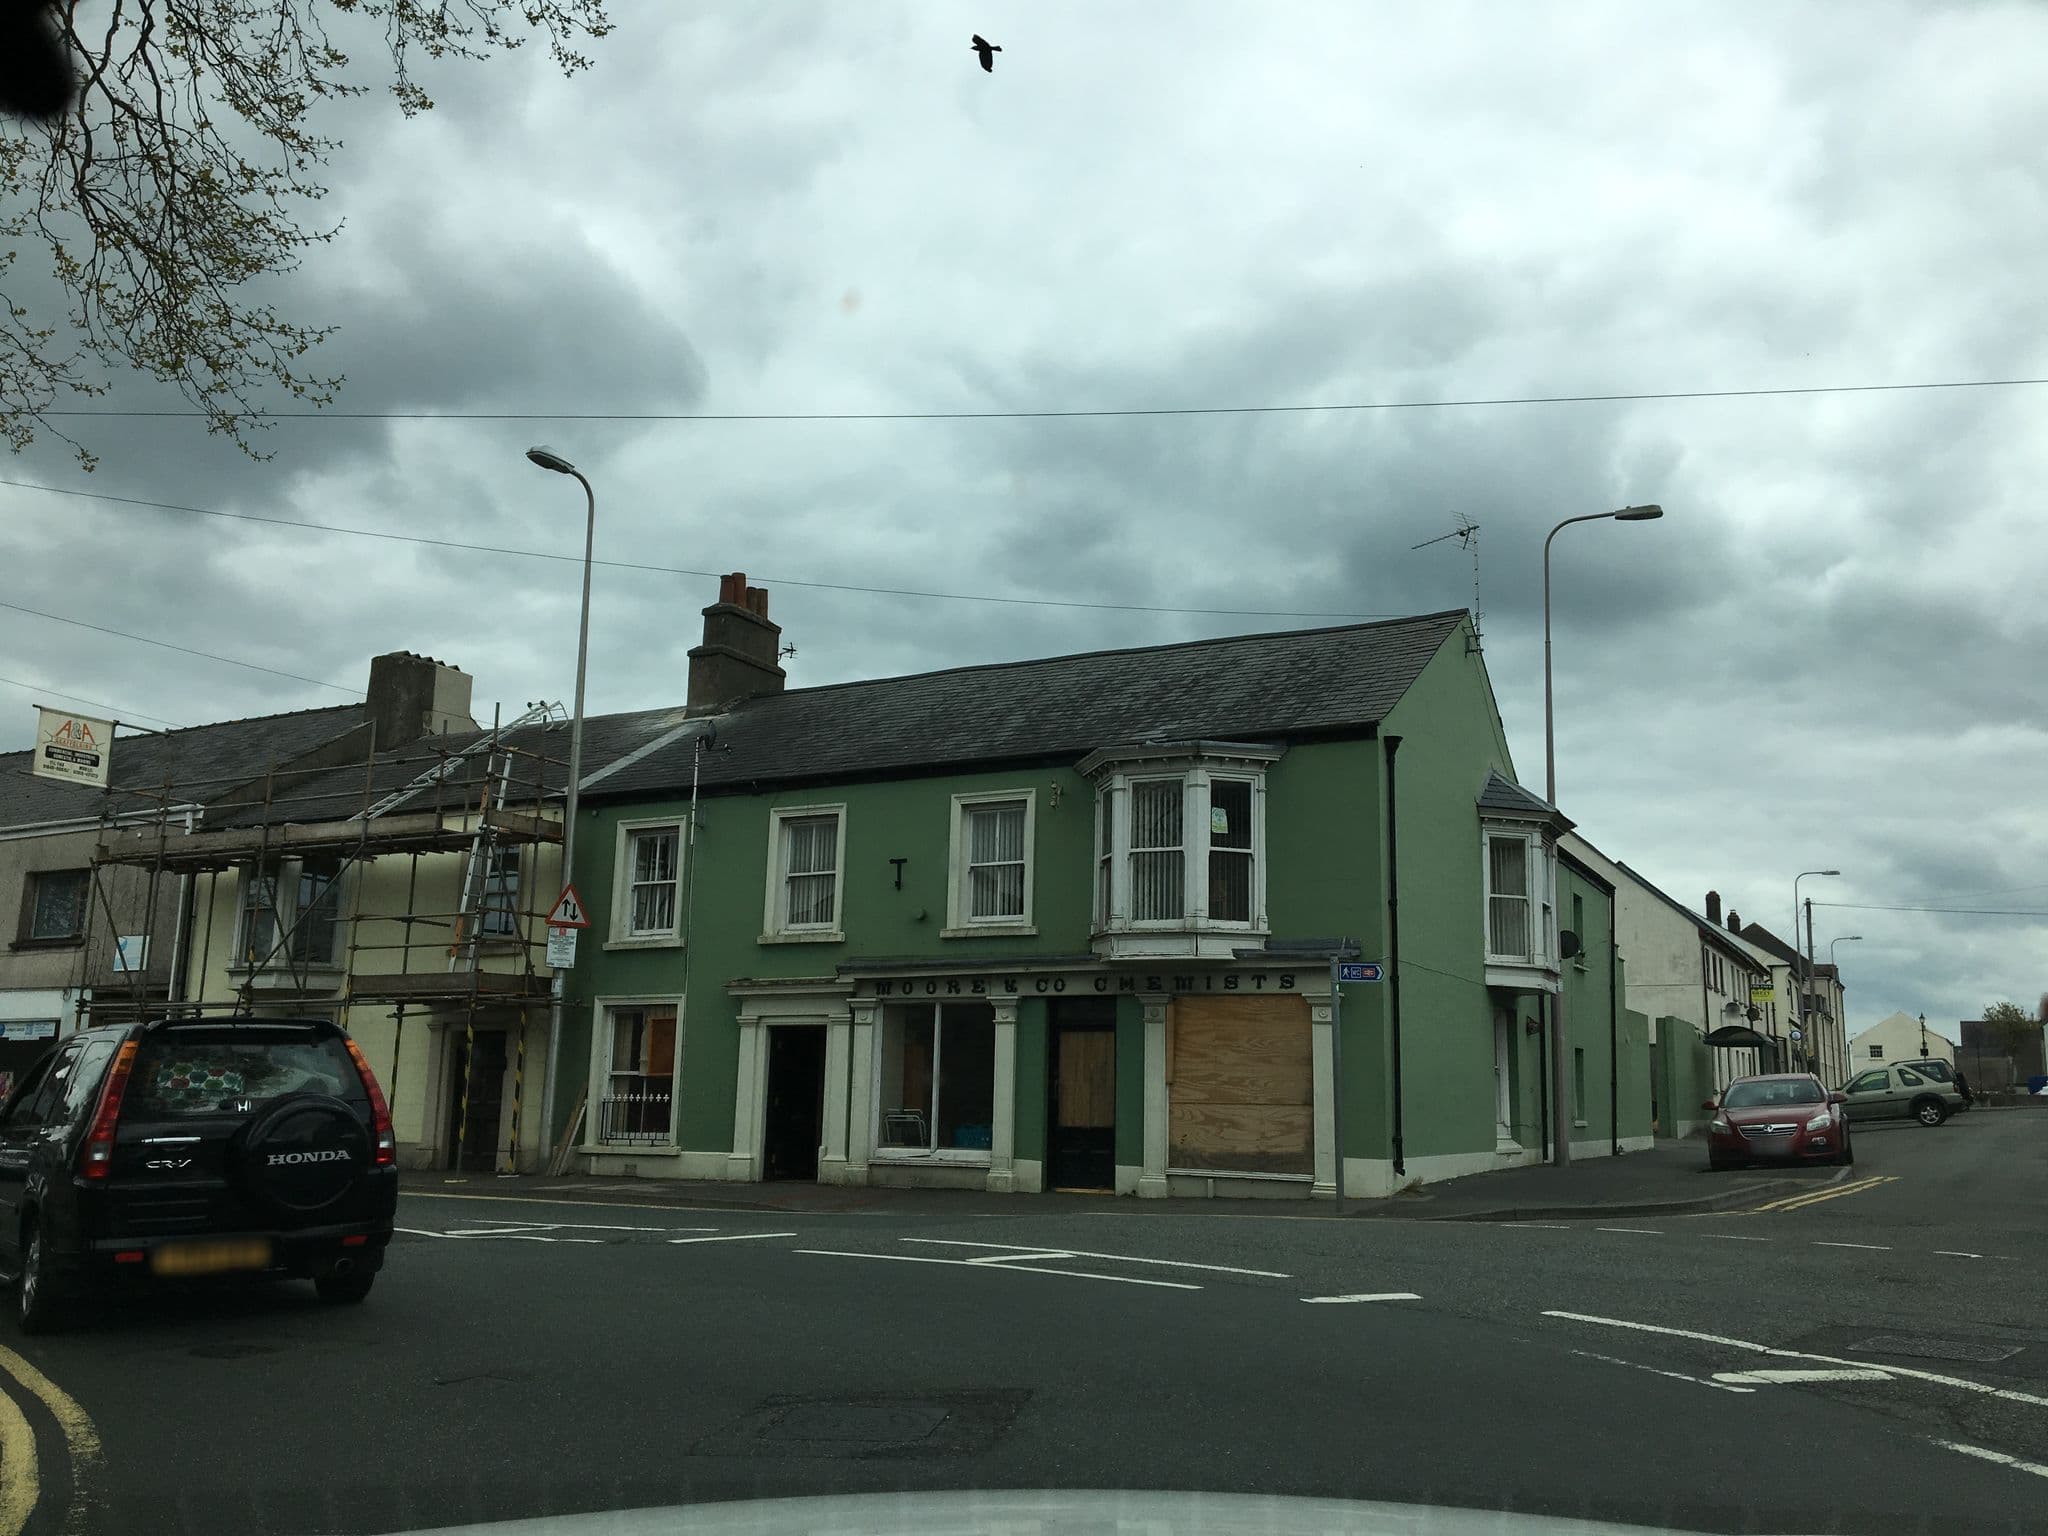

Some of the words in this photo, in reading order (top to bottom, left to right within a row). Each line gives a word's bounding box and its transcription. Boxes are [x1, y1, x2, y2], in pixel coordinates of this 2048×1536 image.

[55, 719, 96, 744] A&A
[875, 978, 986, 996] MOORE
[1004, 978, 1018, 993] &
[1035, 977, 1066, 993] CO
[1094, 974, 1296, 992] CHEMISTS
[145, 1159, 192, 1169] CR-V
[267, 1149, 352, 1166] HONDA
